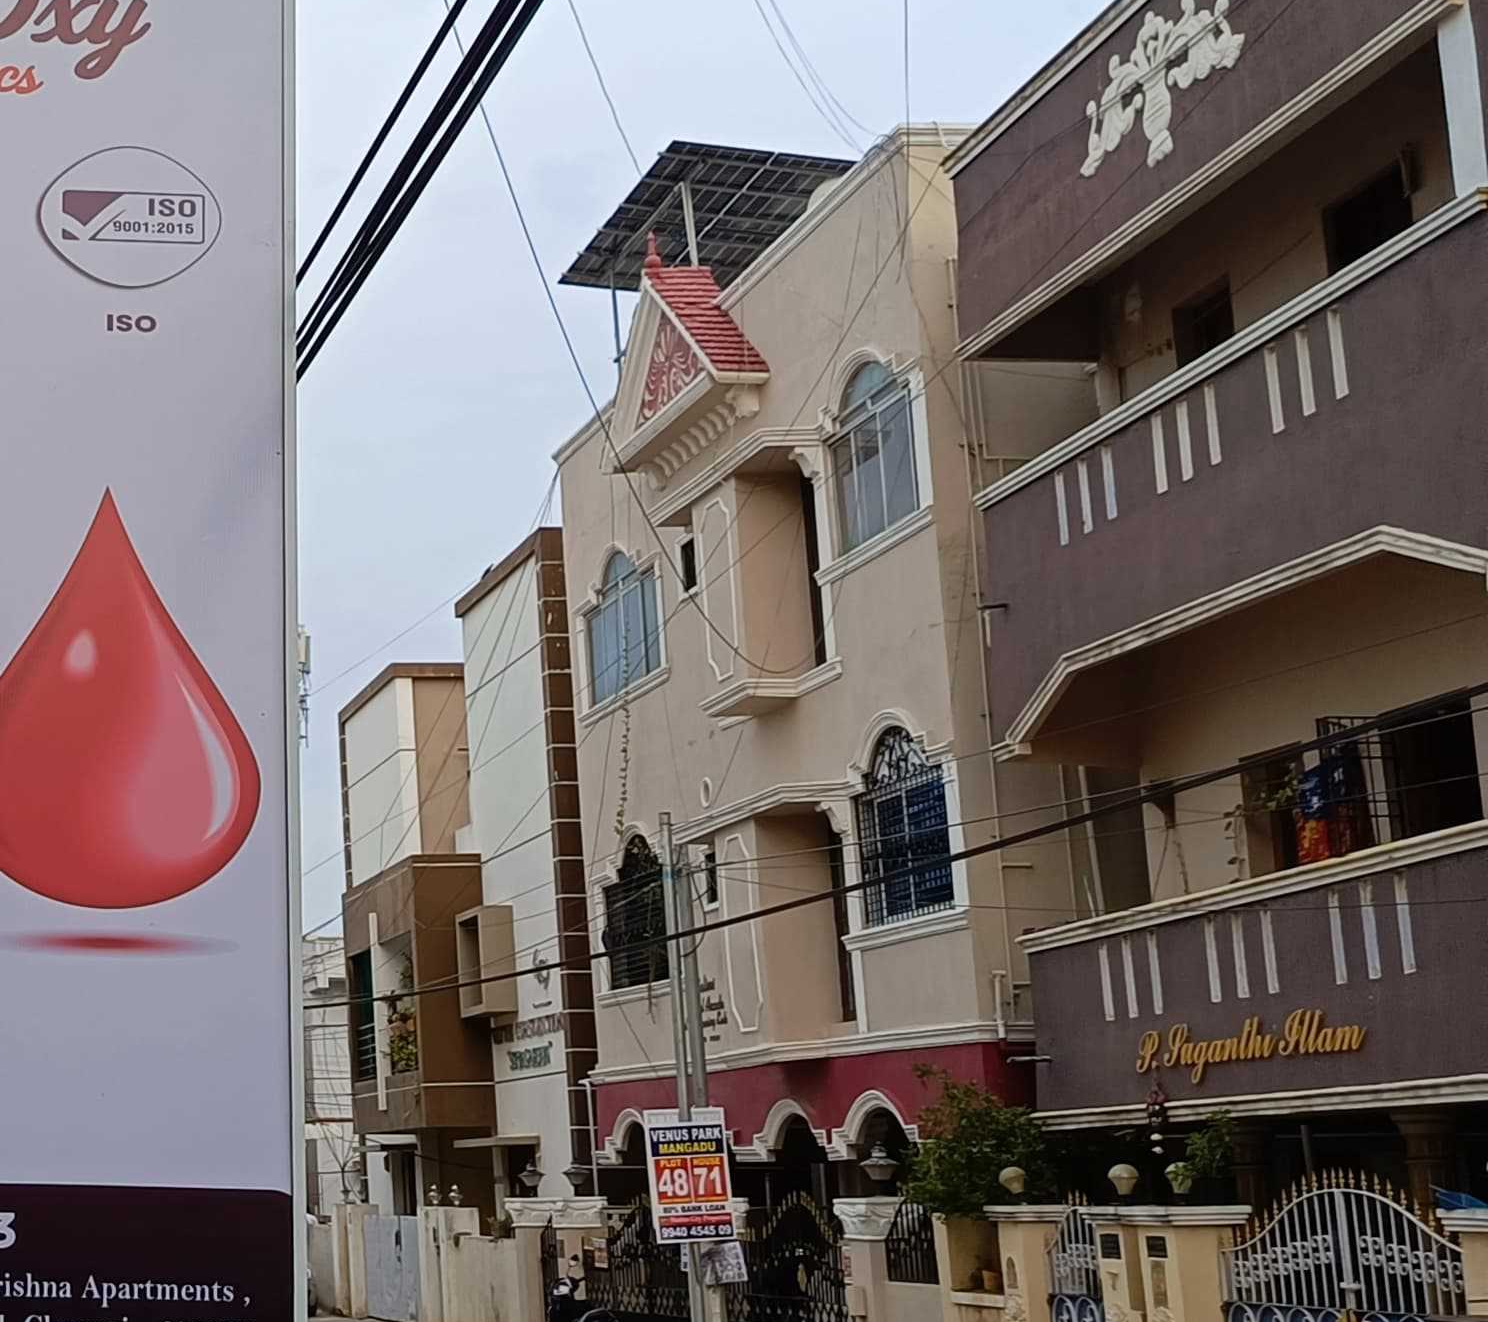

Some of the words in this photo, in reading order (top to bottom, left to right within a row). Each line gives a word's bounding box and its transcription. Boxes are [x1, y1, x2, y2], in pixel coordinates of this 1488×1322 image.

[148, 198, 196, 218] ISO
[113, 221, 194, 235] 9001:2015
[106, 314, 157, 333] ISO
[1136, 1030, 1160, 1073] P.
[1278, 1008, 1366, 1056] Illam
[650, 1128, 689, 1142] VENUS
[692, 1127, 722, 1140] PARK
[659, 1141, 716, 1154] MANGADU
[660, 1159, 682, 1168] PLOT
[658, 1168, 690, 1197] 48
[693, 1166, 723, 1195] 71
[681, 1205, 703, 1213] BANK
[662, 1227, 688, 1238] 9940
[690, 1225, 716, 1236] 4545
[81, 1275, 234, 1307] Apartments
